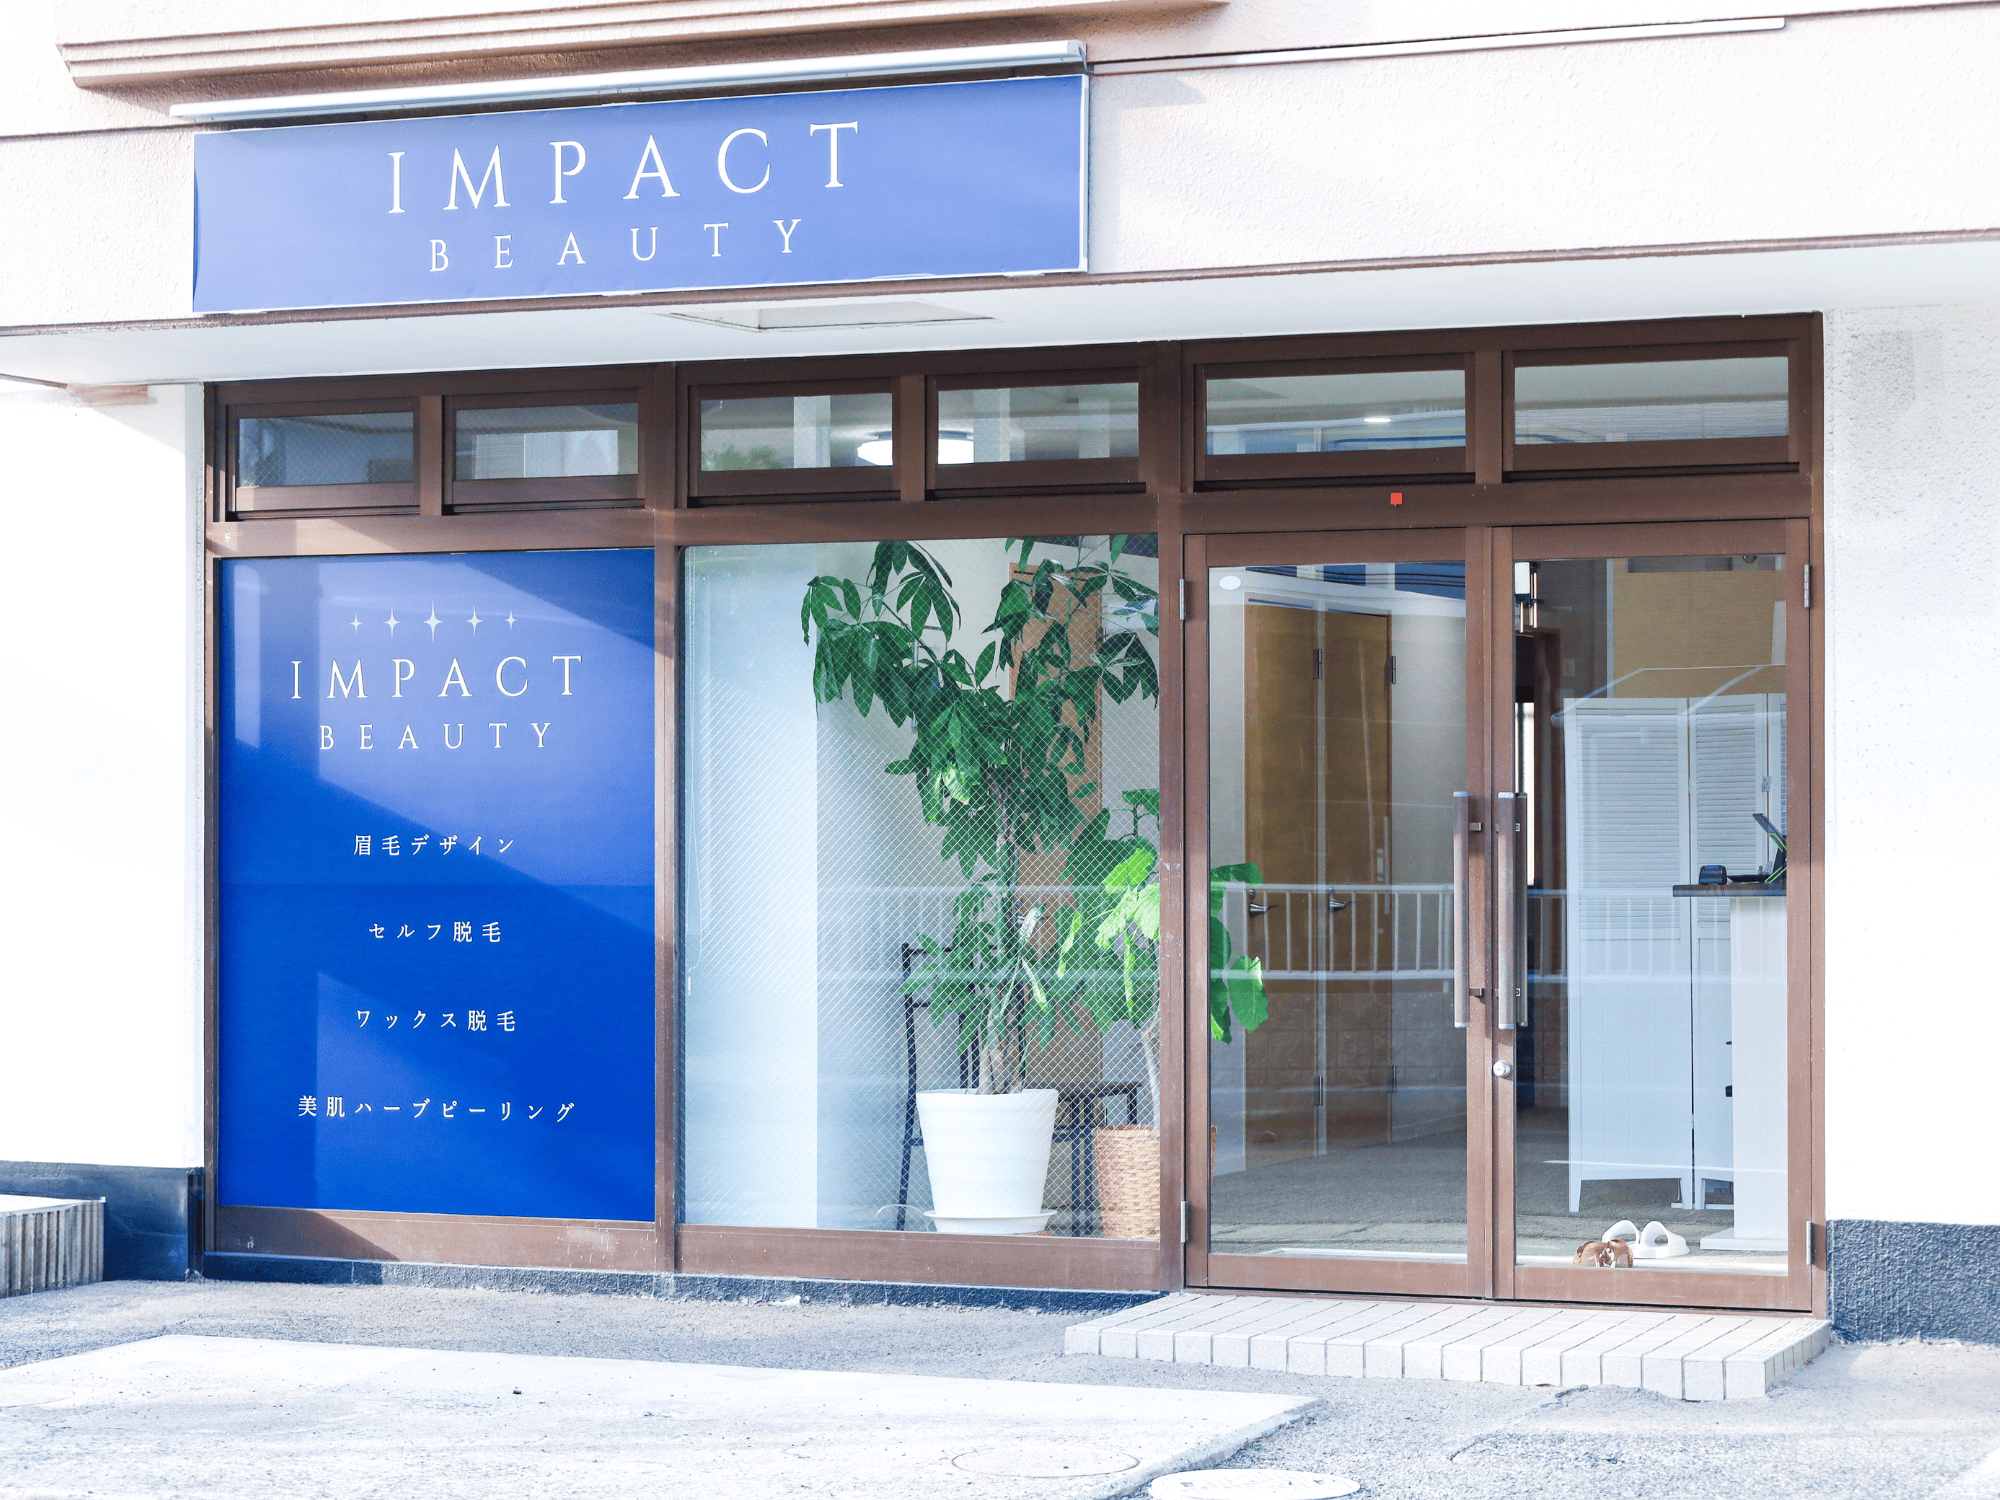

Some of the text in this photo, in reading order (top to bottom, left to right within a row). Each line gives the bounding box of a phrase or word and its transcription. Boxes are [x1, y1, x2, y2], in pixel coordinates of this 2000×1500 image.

[387, 121, 859, 214] IMPACT
[429, 218, 802, 273] BEAUTY
[290, 655, 582, 699] IMPACT
[319, 722, 552, 750] BEAUTY
[353, 834, 514, 856] 眉毛デザイン
[368, 921, 502, 943] セルフ脱毛
[356, 1010, 516, 1032] ワックス脱毛
[298, 1095, 575, 1122] 美肌ハーブピーリング
